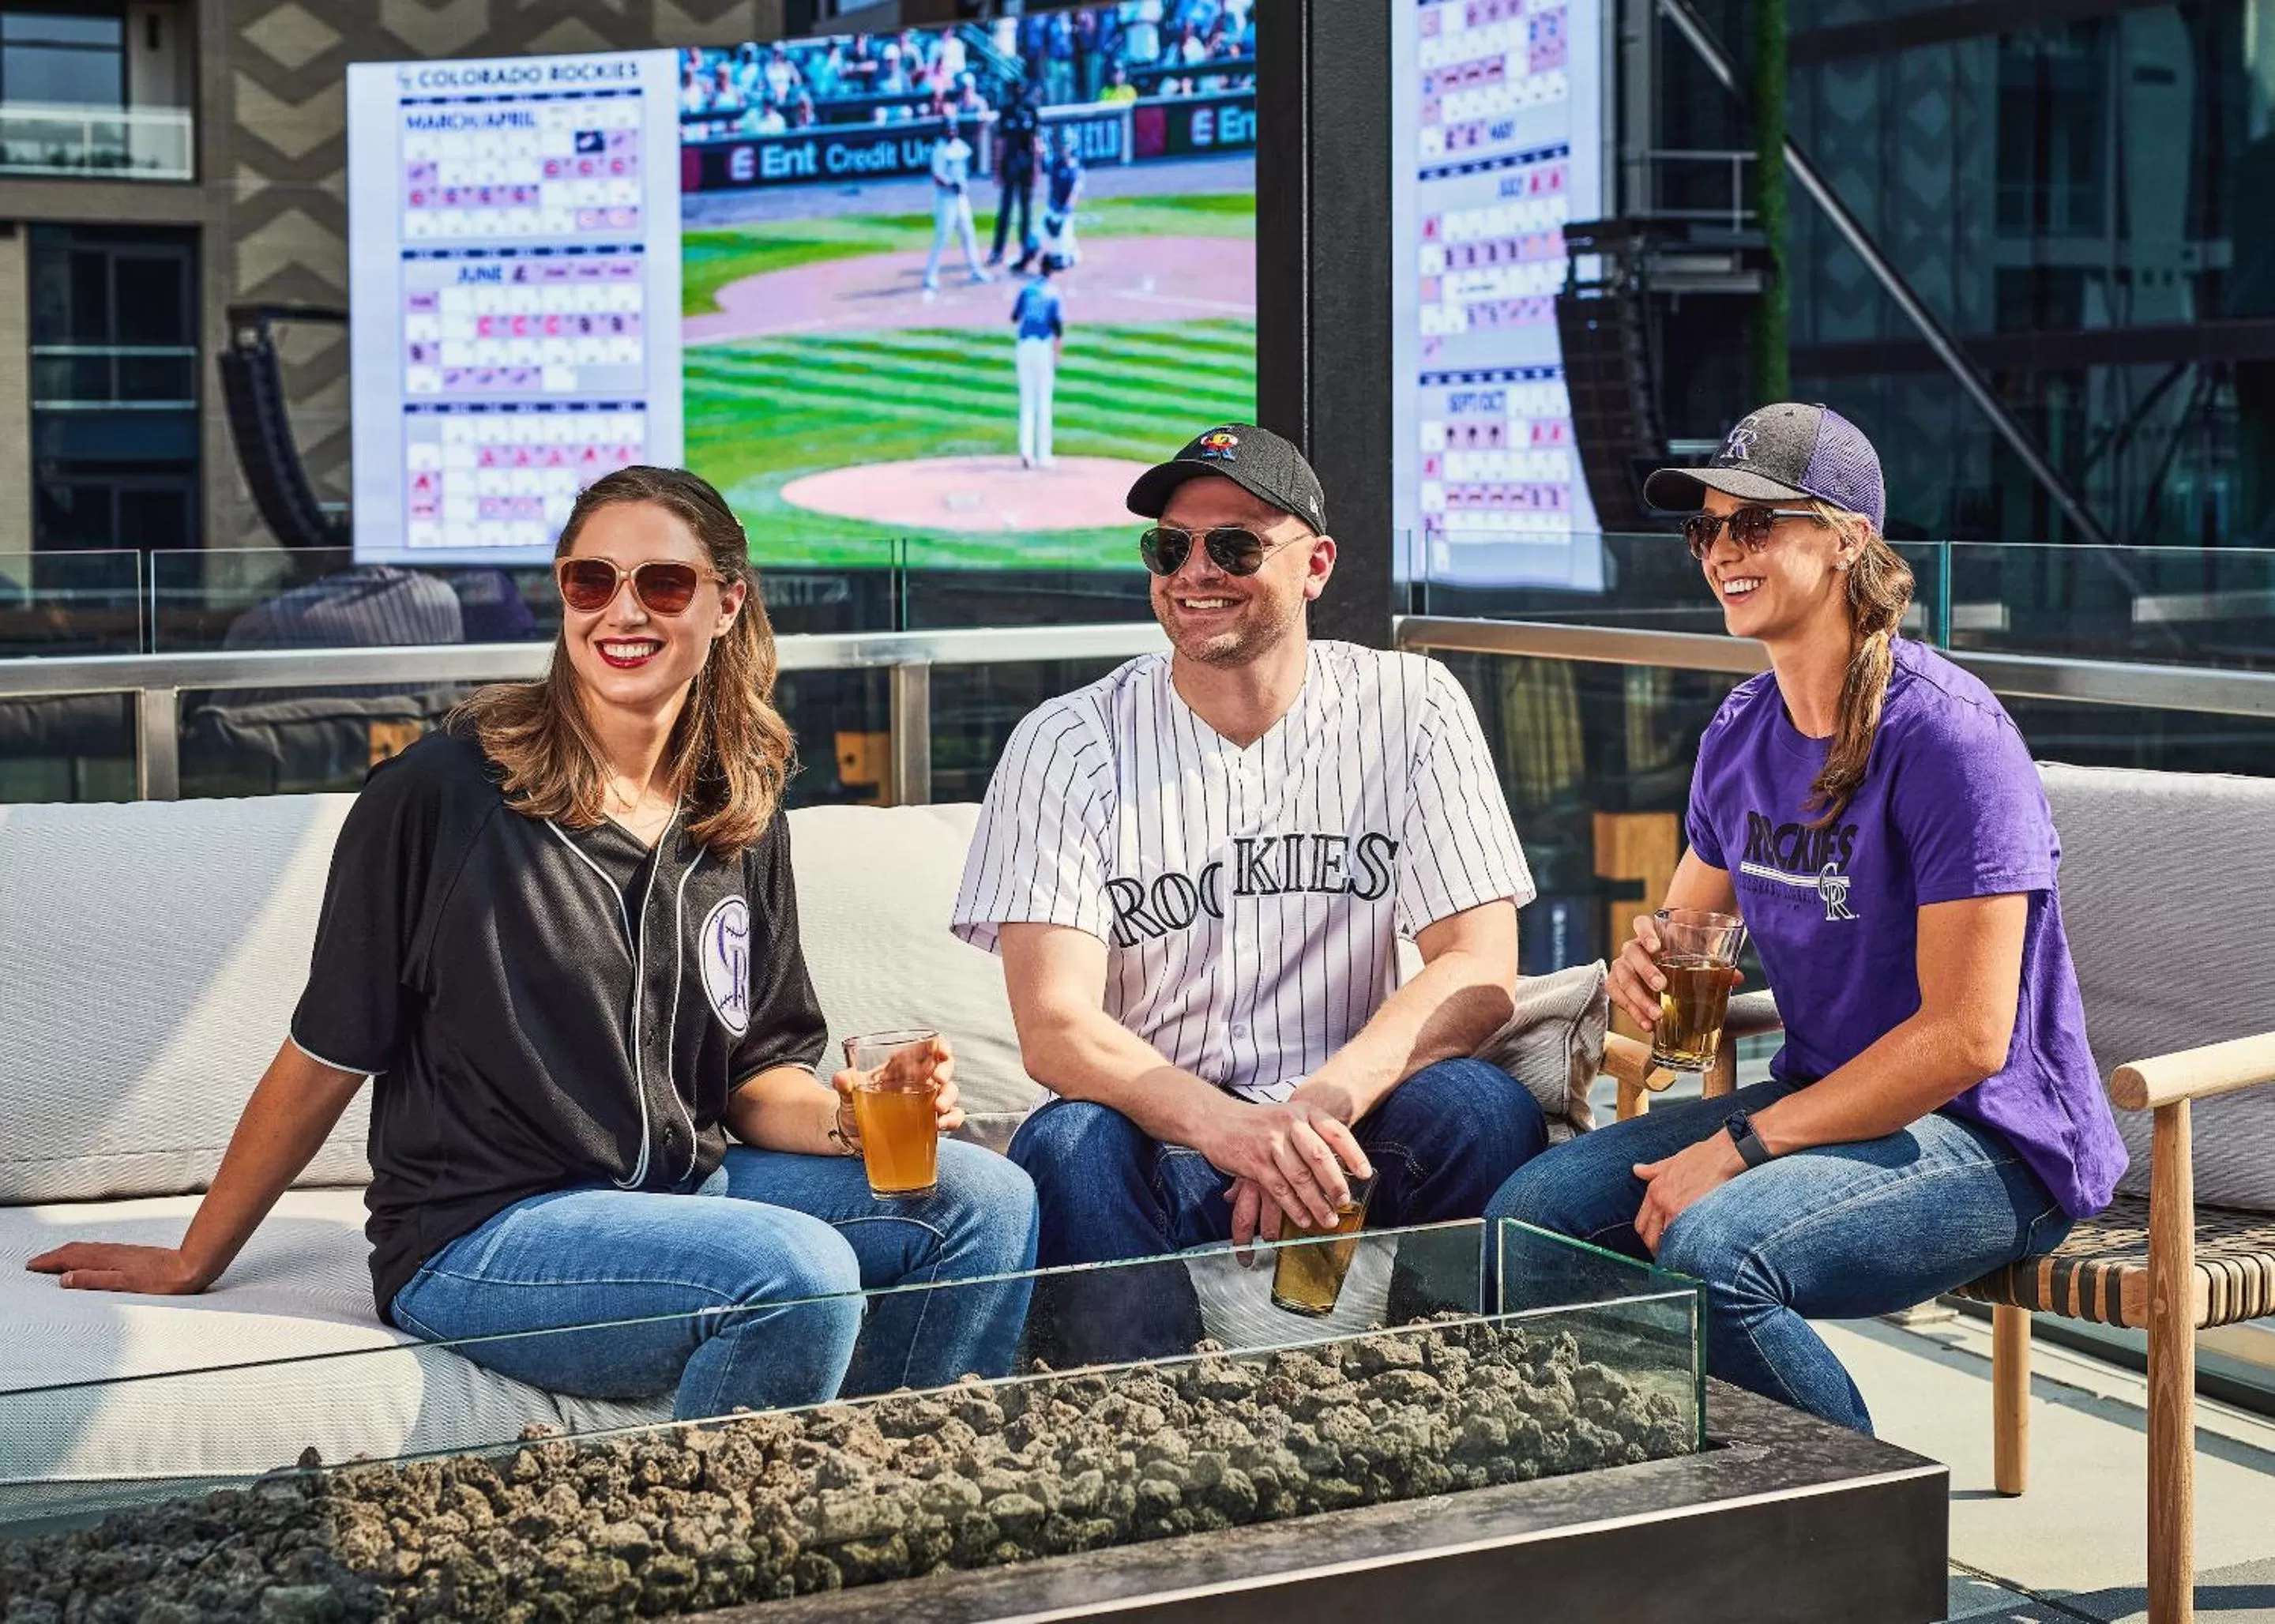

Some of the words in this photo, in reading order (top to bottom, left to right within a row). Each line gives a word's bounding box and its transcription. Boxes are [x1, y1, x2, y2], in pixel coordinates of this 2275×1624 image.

[418, 67, 542, 88] COLORADO
[549, 61, 639, 81] ROCKIES
[1218, 106, 1256, 143] En
[760, 139, 818, 178] Ent
[825, 139, 897, 173] Credit
[458, 265, 502, 283] JUNE
[1105, 832, 1399, 948] ROCKIES
